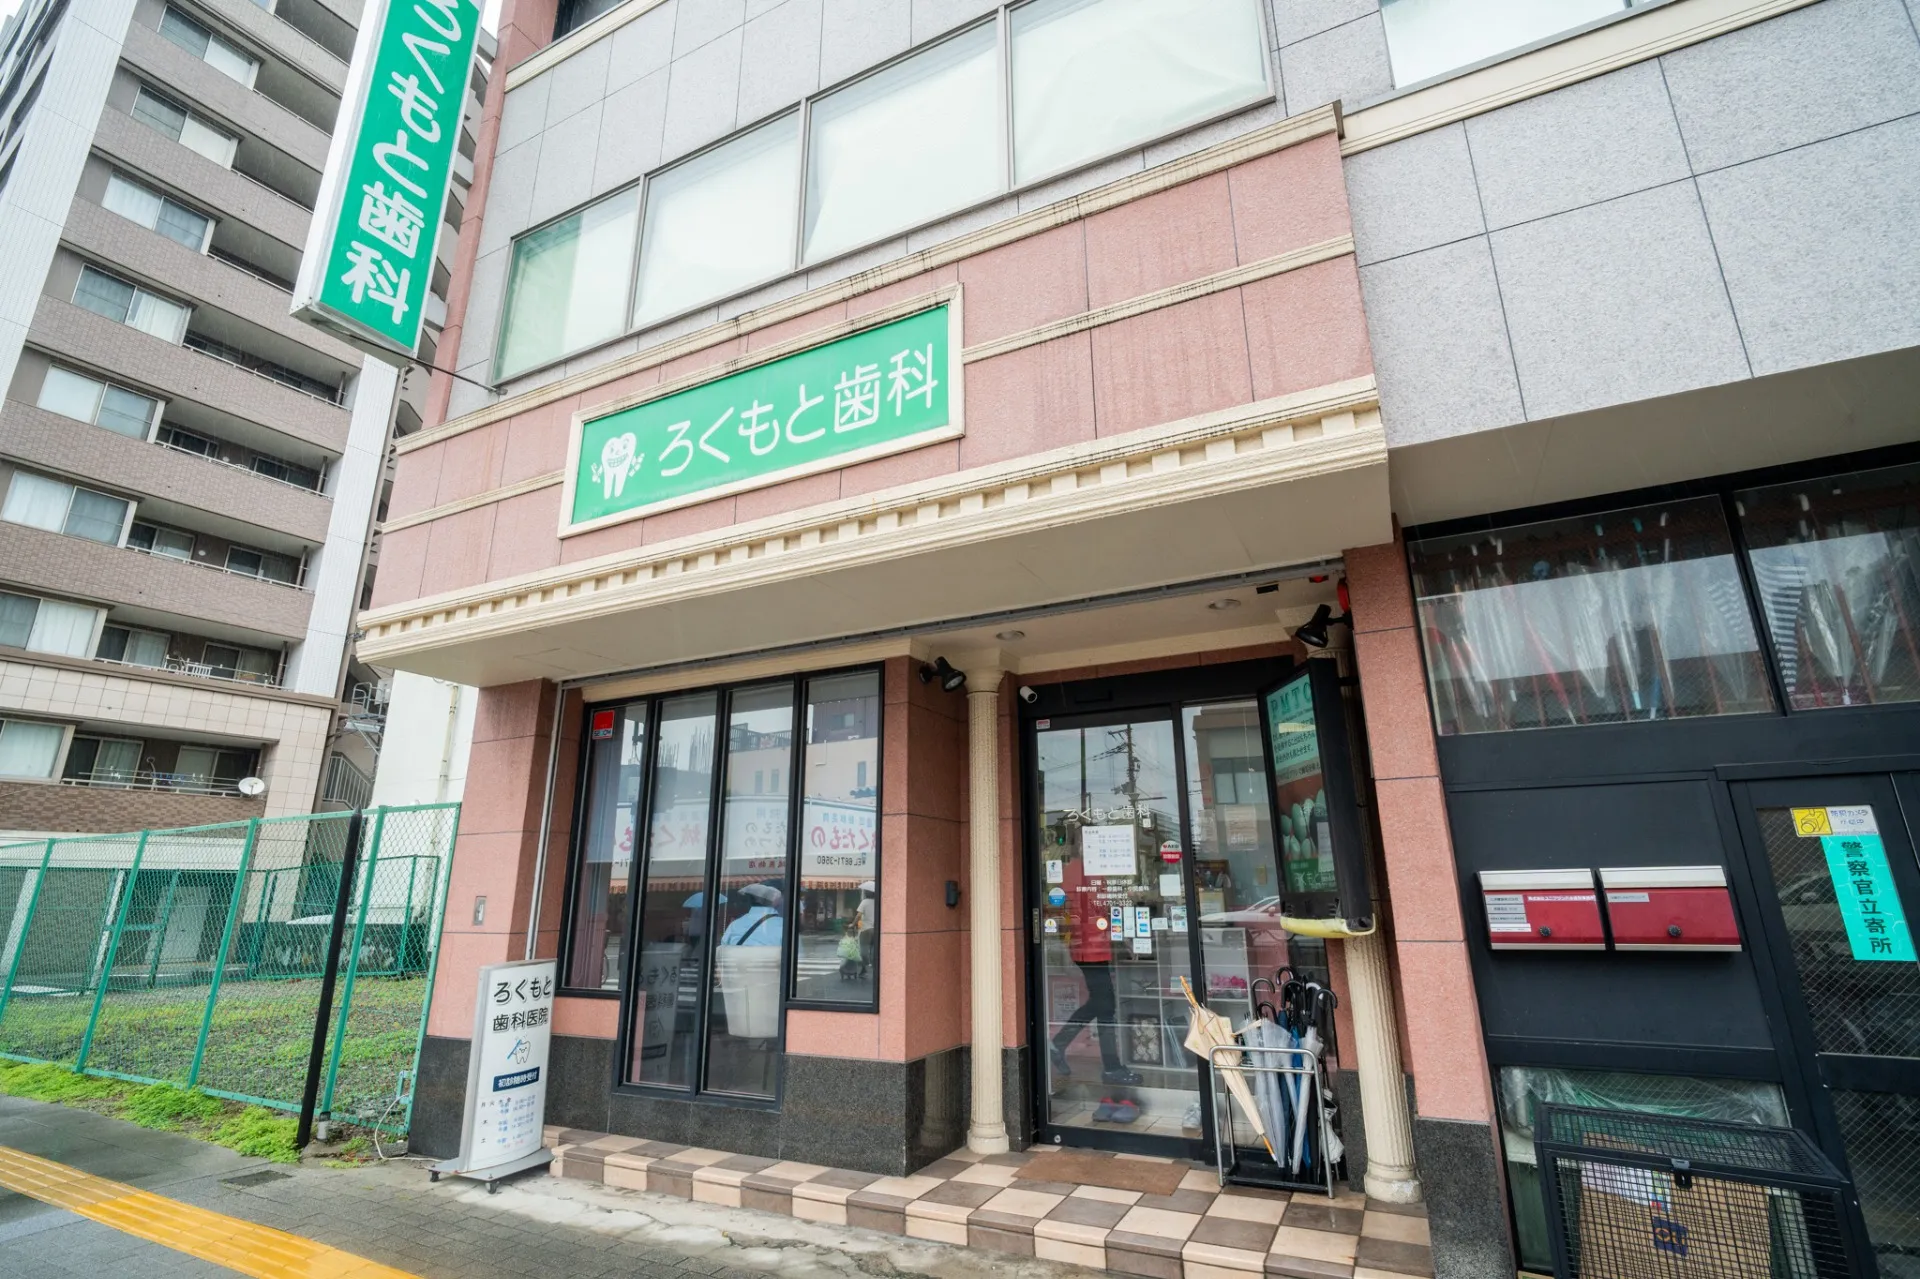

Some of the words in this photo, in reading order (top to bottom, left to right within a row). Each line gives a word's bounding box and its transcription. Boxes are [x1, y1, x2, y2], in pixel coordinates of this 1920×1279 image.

[658, 343, 938, 477] ろくもと歯科
[1066, 804, 1151, 822] ろくもと歯科
[1841, 841, 1893, 955] 警察官立寄所
[493, 976, 552, 1004] ろくもと
[492, 1006, 549, 1033] 歯科医院
